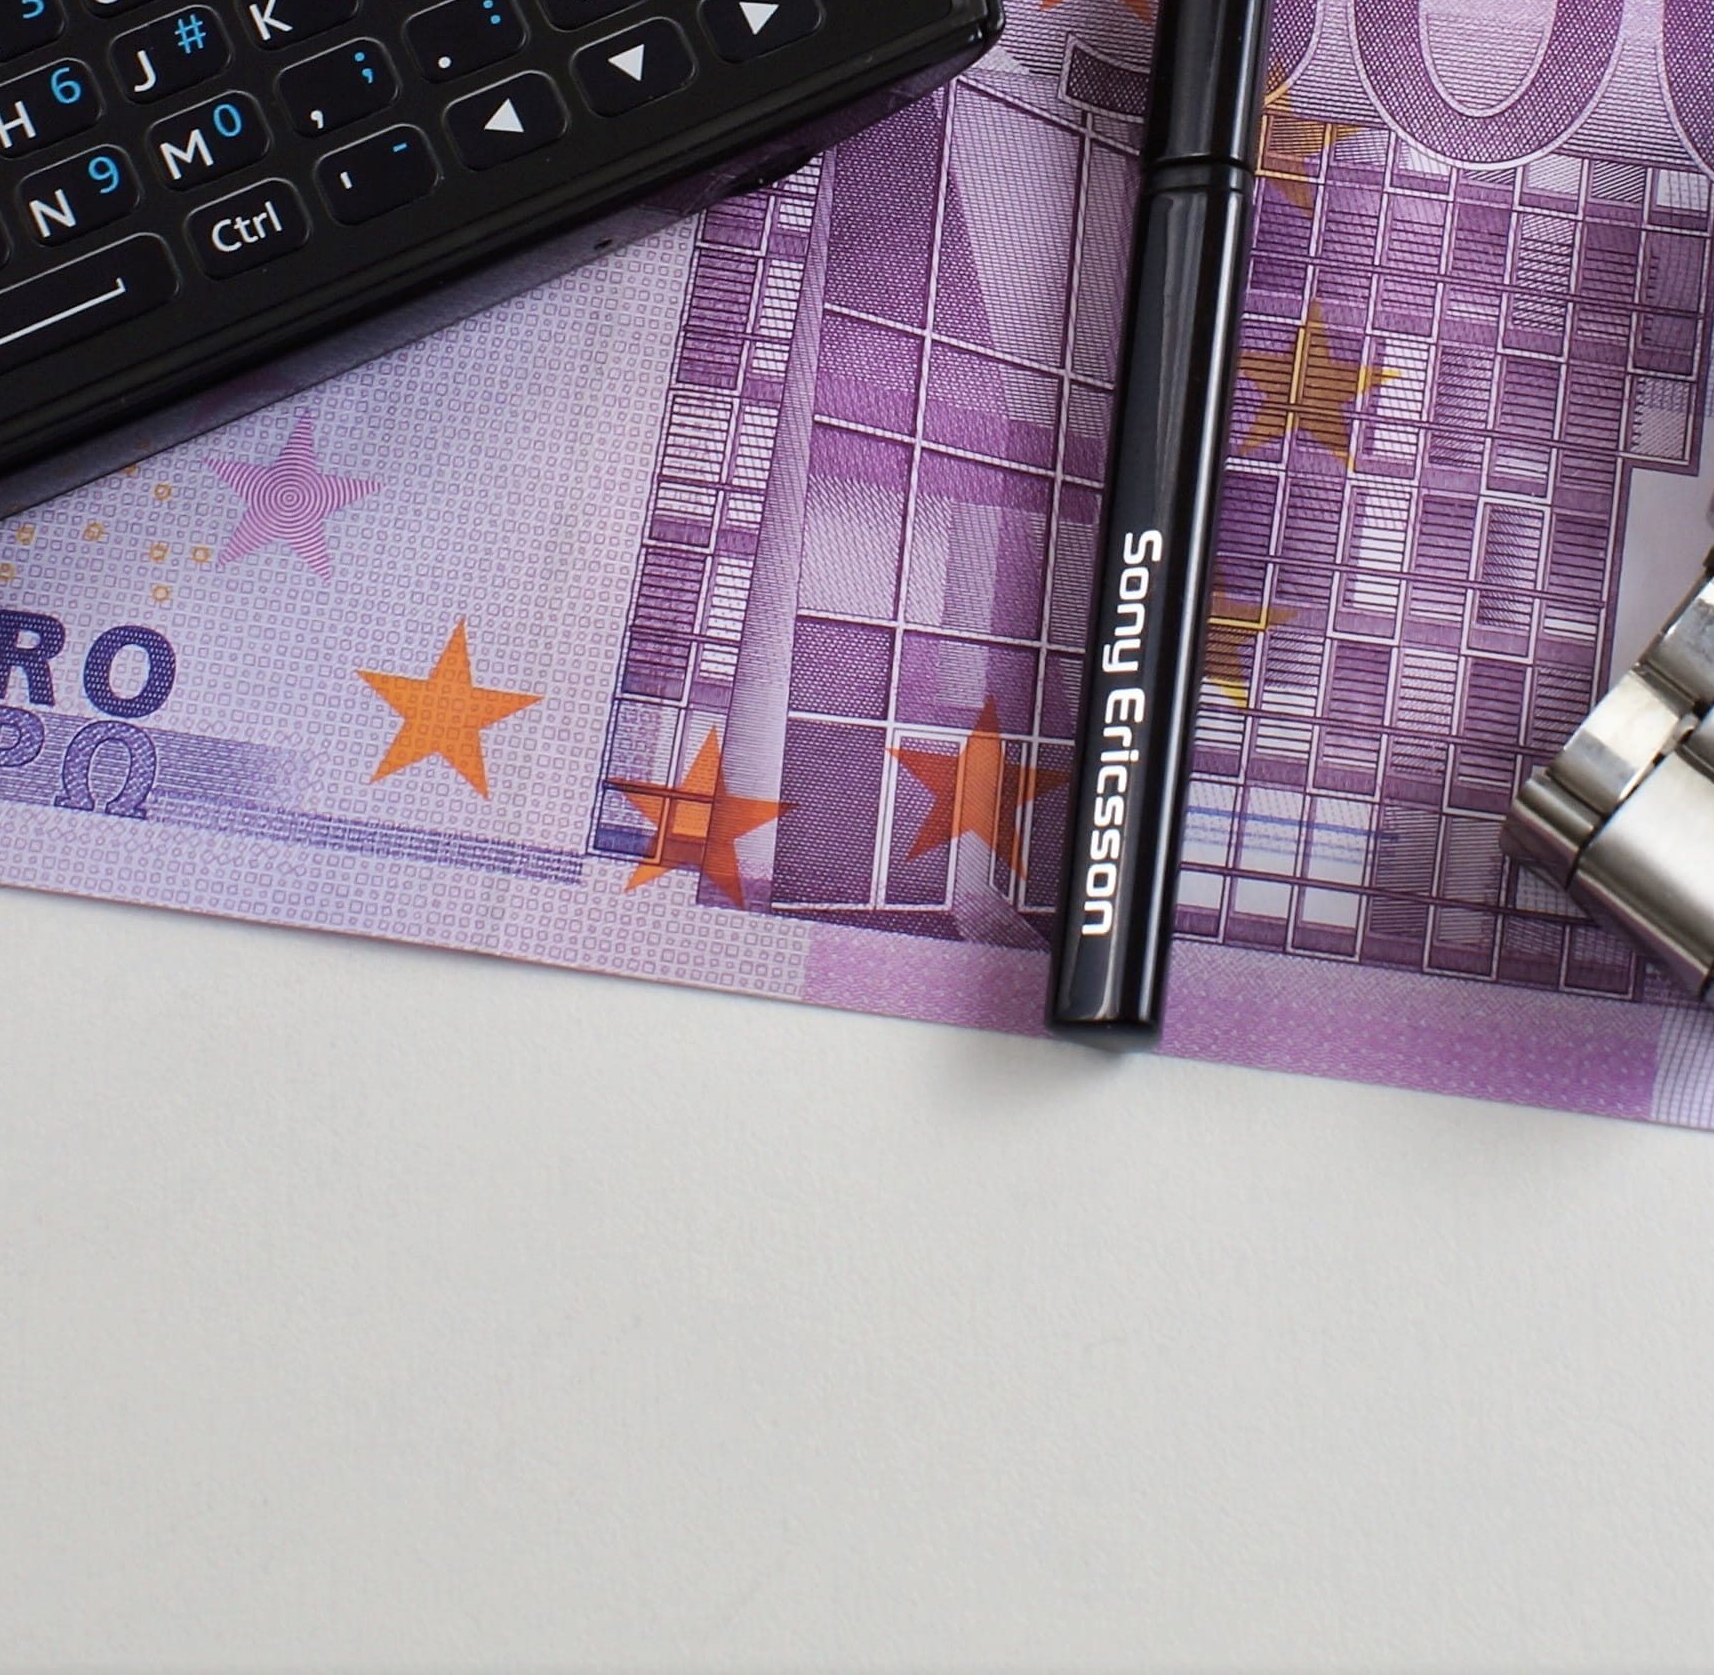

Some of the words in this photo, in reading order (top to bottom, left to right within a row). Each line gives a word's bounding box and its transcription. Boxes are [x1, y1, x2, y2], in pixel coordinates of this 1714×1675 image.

[46, 64, 82, 104] 6
[134, 50, 157, 93] J
[172, 11, 207, 54] #
[159, 128, 214, 180] M
[29, 188, 77, 238] N
[88, 156, 120, 194] 9
[209, 200, 284, 253] Ctrl
[1101, 528, 1164, 674] Sony
[1081, 687, 1146, 937] Ericsson
